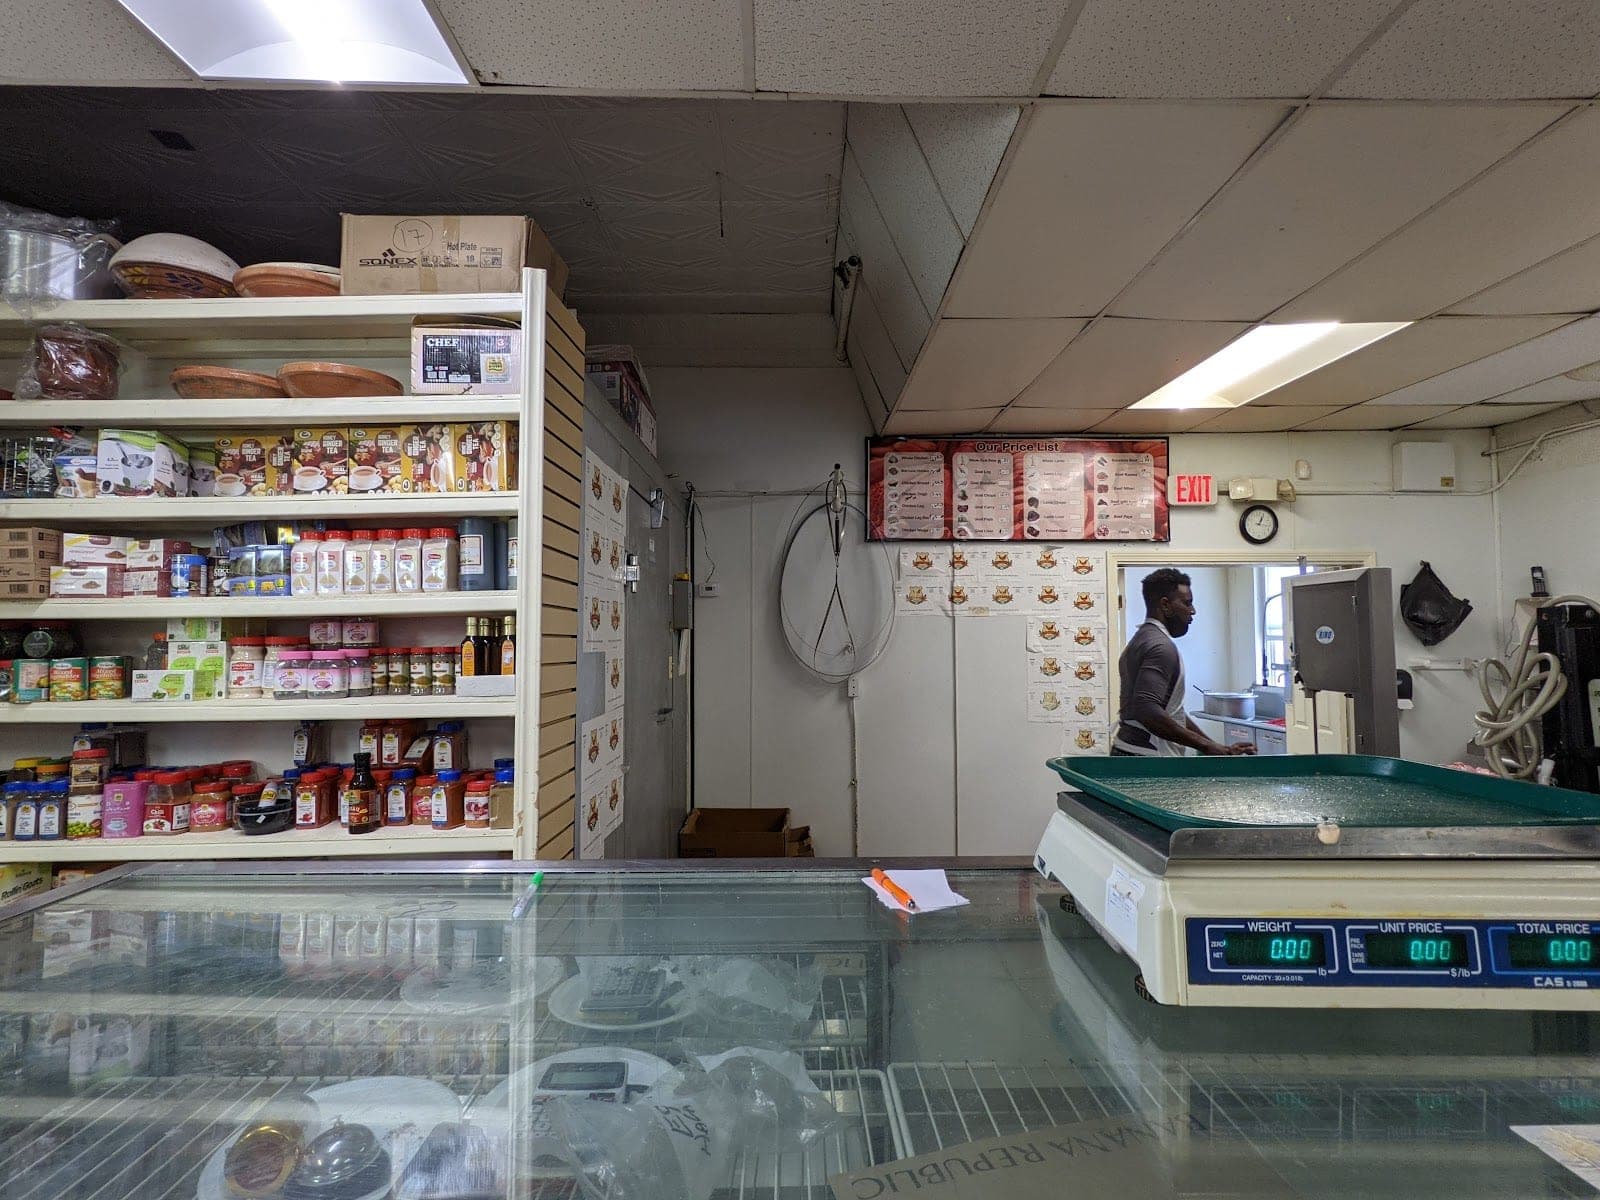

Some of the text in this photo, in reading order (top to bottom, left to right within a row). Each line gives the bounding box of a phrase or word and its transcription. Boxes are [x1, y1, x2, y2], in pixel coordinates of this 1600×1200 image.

[400, 227, 425, 247] 17
[447, 242, 459, 251] Hot
[460, 242, 478, 251] Plate
[426, 338, 460, 347] CHEF
[326, 446, 338, 454] TEA
[976, 441, 1059, 452] Our Price List
[245, 454, 257, 462] TEA
[1176, 475, 1212, 502] EXIT
[1247, 921, 1292, 933] WEIGHT
[1380, 922, 1443, 933] UNIT PRICE
[1516, 923, 1592, 935] TOTAL PRICE
[1270, 939, 1311, 959] 0.00
[1410, 940, 1451, 960] 0.00
[1550, 940, 1591, 961] 0.00
[1318, 967, 1327, 976] lb
[1450, 968, 1471, 978] $/lb
[1533, 977, 1564, 987] CAS
[850, 1141, 1047, 1200] REPUBLIC
